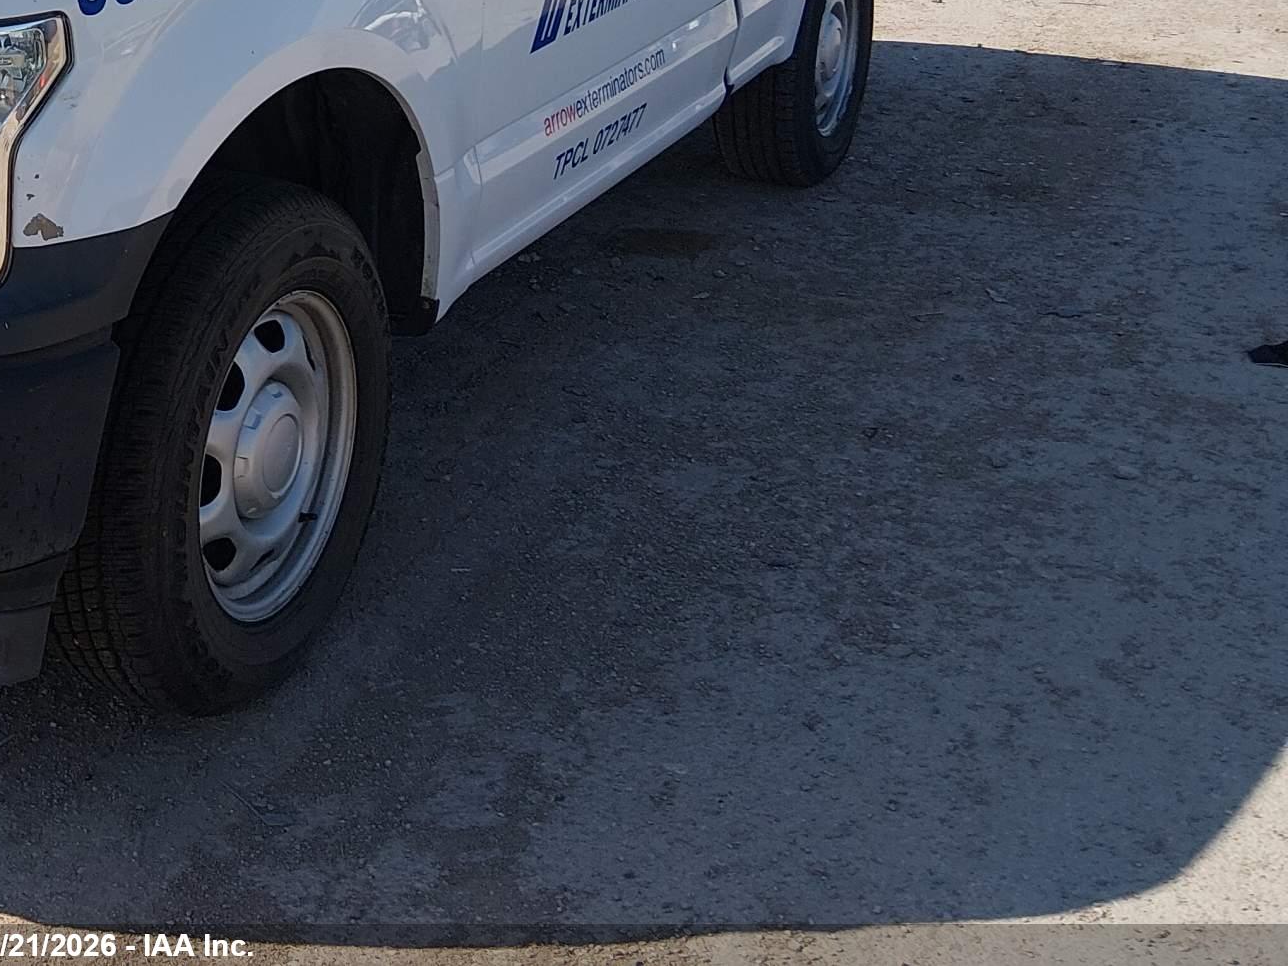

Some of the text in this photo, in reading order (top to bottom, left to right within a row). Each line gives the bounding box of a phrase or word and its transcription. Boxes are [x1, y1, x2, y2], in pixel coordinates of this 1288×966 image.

[544, 48, 666, 137] arrowexterminators.com
[553, 102, 648, 180] TPCL 0727477
